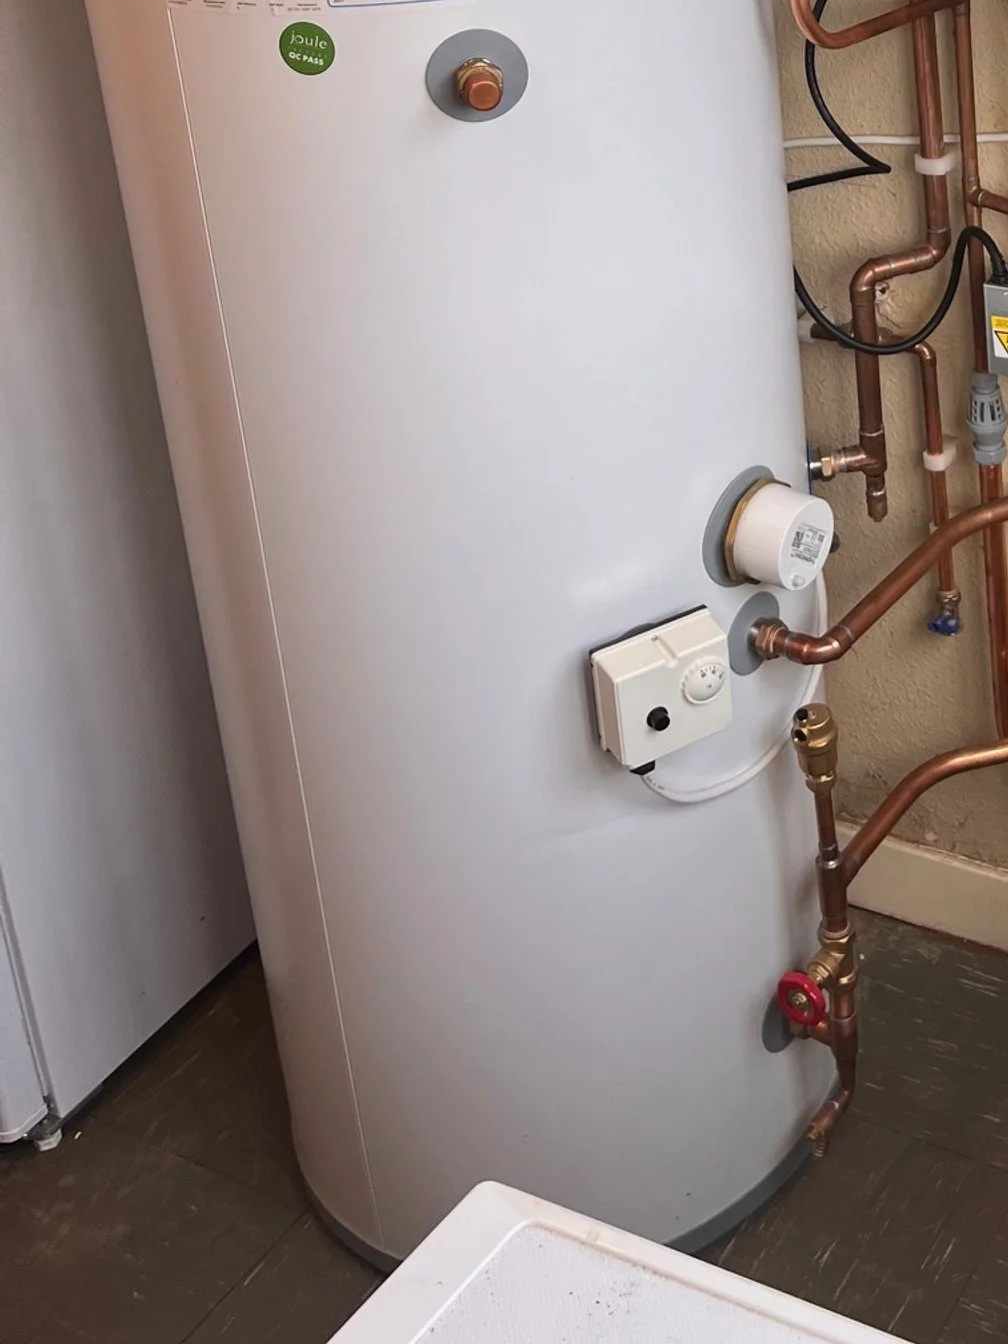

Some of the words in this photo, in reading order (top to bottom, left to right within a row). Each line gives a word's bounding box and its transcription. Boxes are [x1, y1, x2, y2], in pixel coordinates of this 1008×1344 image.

[290, 30, 328, 49] joule
[289, 51, 301, 61] QC
[302, 54, 324, 66] PASS
